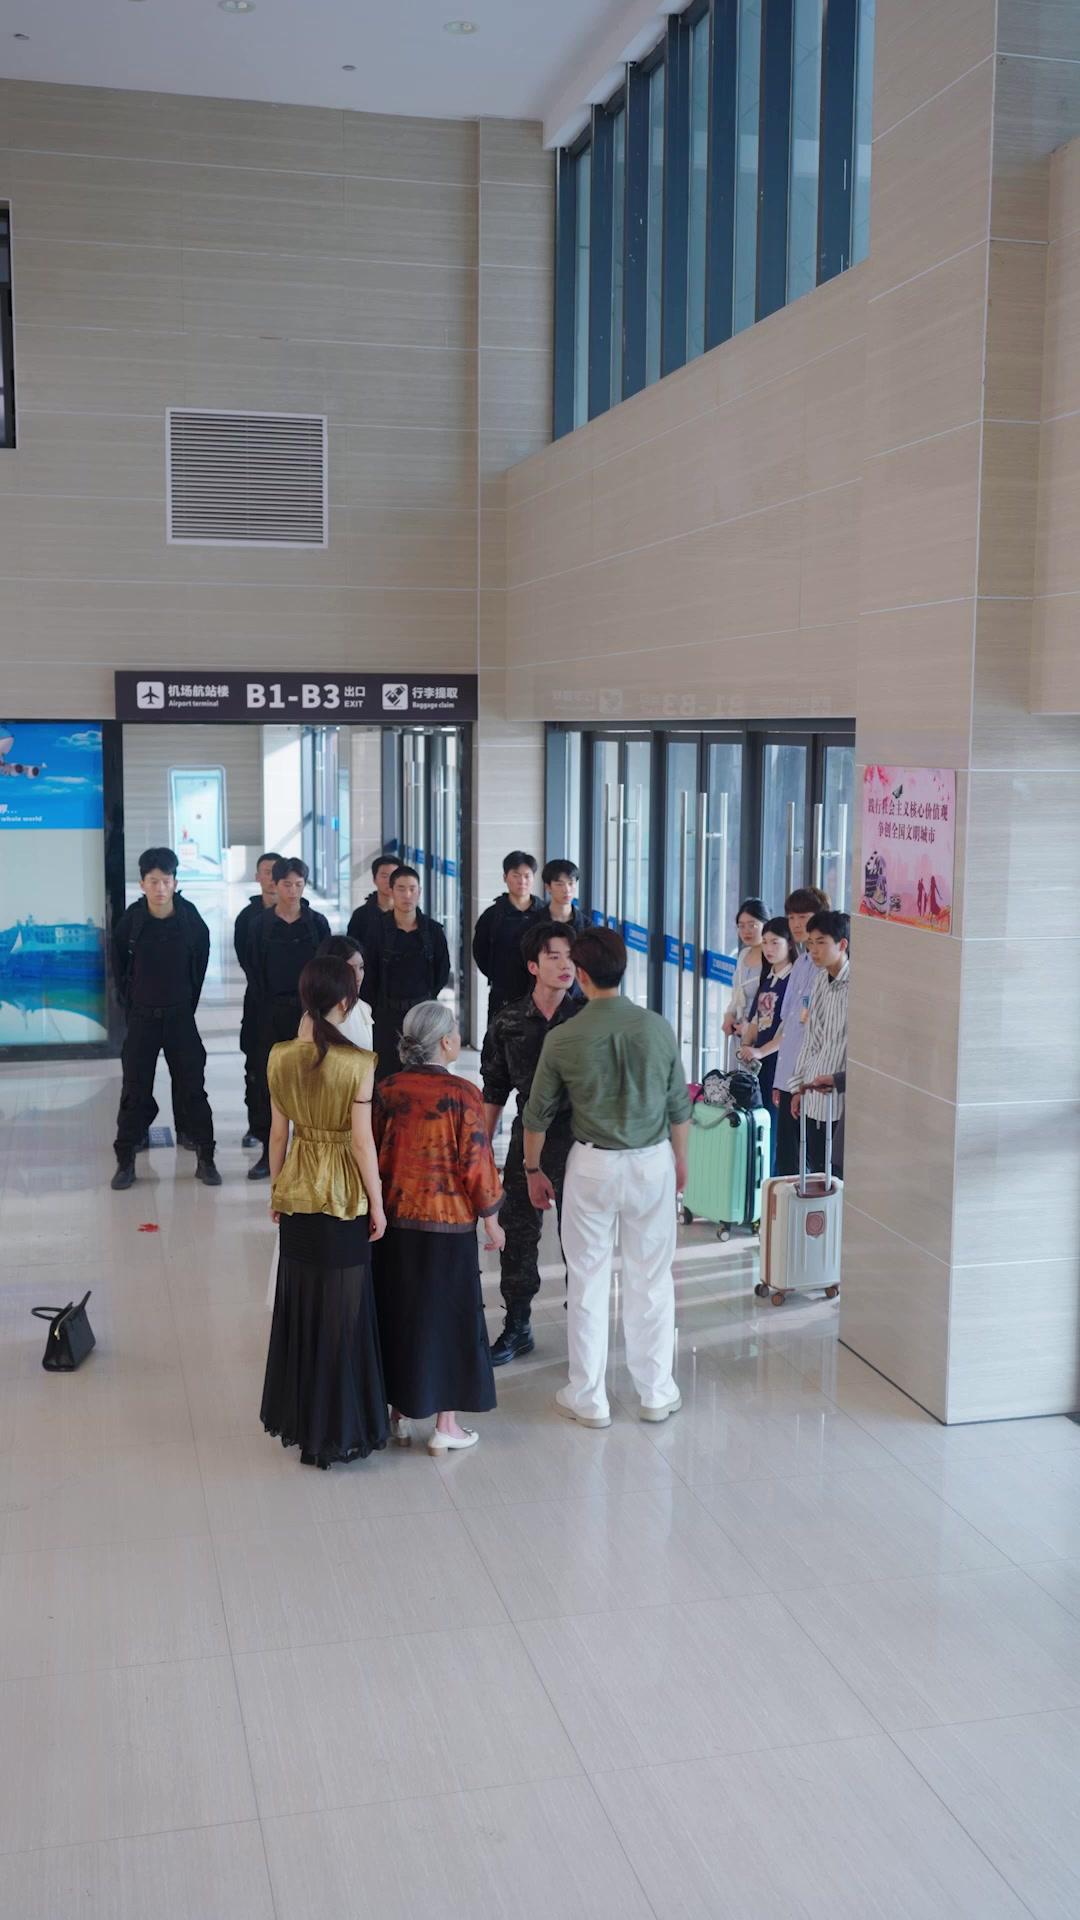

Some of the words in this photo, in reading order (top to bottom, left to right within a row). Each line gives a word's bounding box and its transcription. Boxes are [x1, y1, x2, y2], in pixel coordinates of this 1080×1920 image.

[168, 684, 229, 697] 机场航站楼
[246, 683, 340, 709] B1-B3
[344, 685, 366, 697] 出口
[412, 686, 459, 699] 行李提取
[168, 699, 192, 708] Airport
[192, 699, 219, 707] terminal
[344, 700, 364, 708] EXIT
[412, 701, 438, 709] Baggage
[868, 798, 948, 821] 践行社会主义核心价值观
[879, 822, 936, 844] 争创全国文明城市
